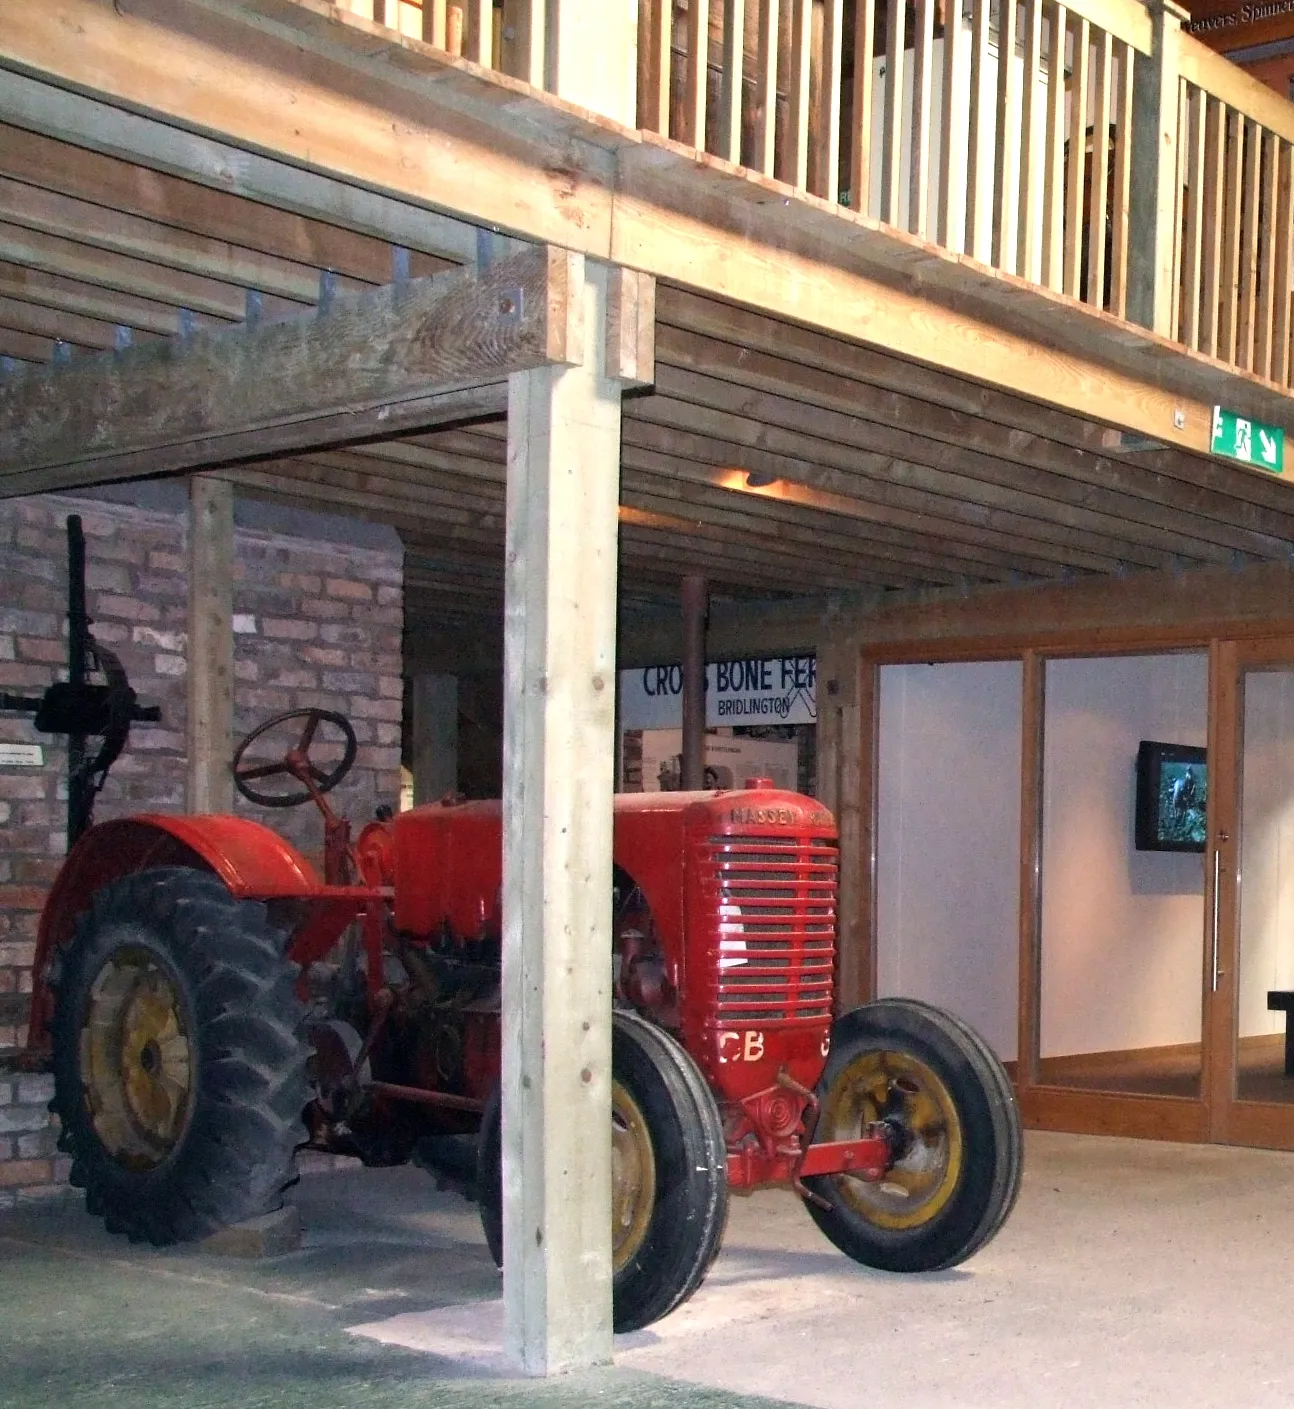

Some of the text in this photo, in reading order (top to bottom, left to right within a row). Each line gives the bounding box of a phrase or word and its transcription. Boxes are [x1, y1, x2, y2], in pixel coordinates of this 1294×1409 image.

[1189, 14, 1238, 34] eavers,
[643, 664, 709, 696] CRO
[717, 660, 773, 692] BONE
[718, 699, 790, 716] BRIDLINGTON
[731, 807, 796, 825] MASSEY
[718, 1031, 765, 1063] CB
